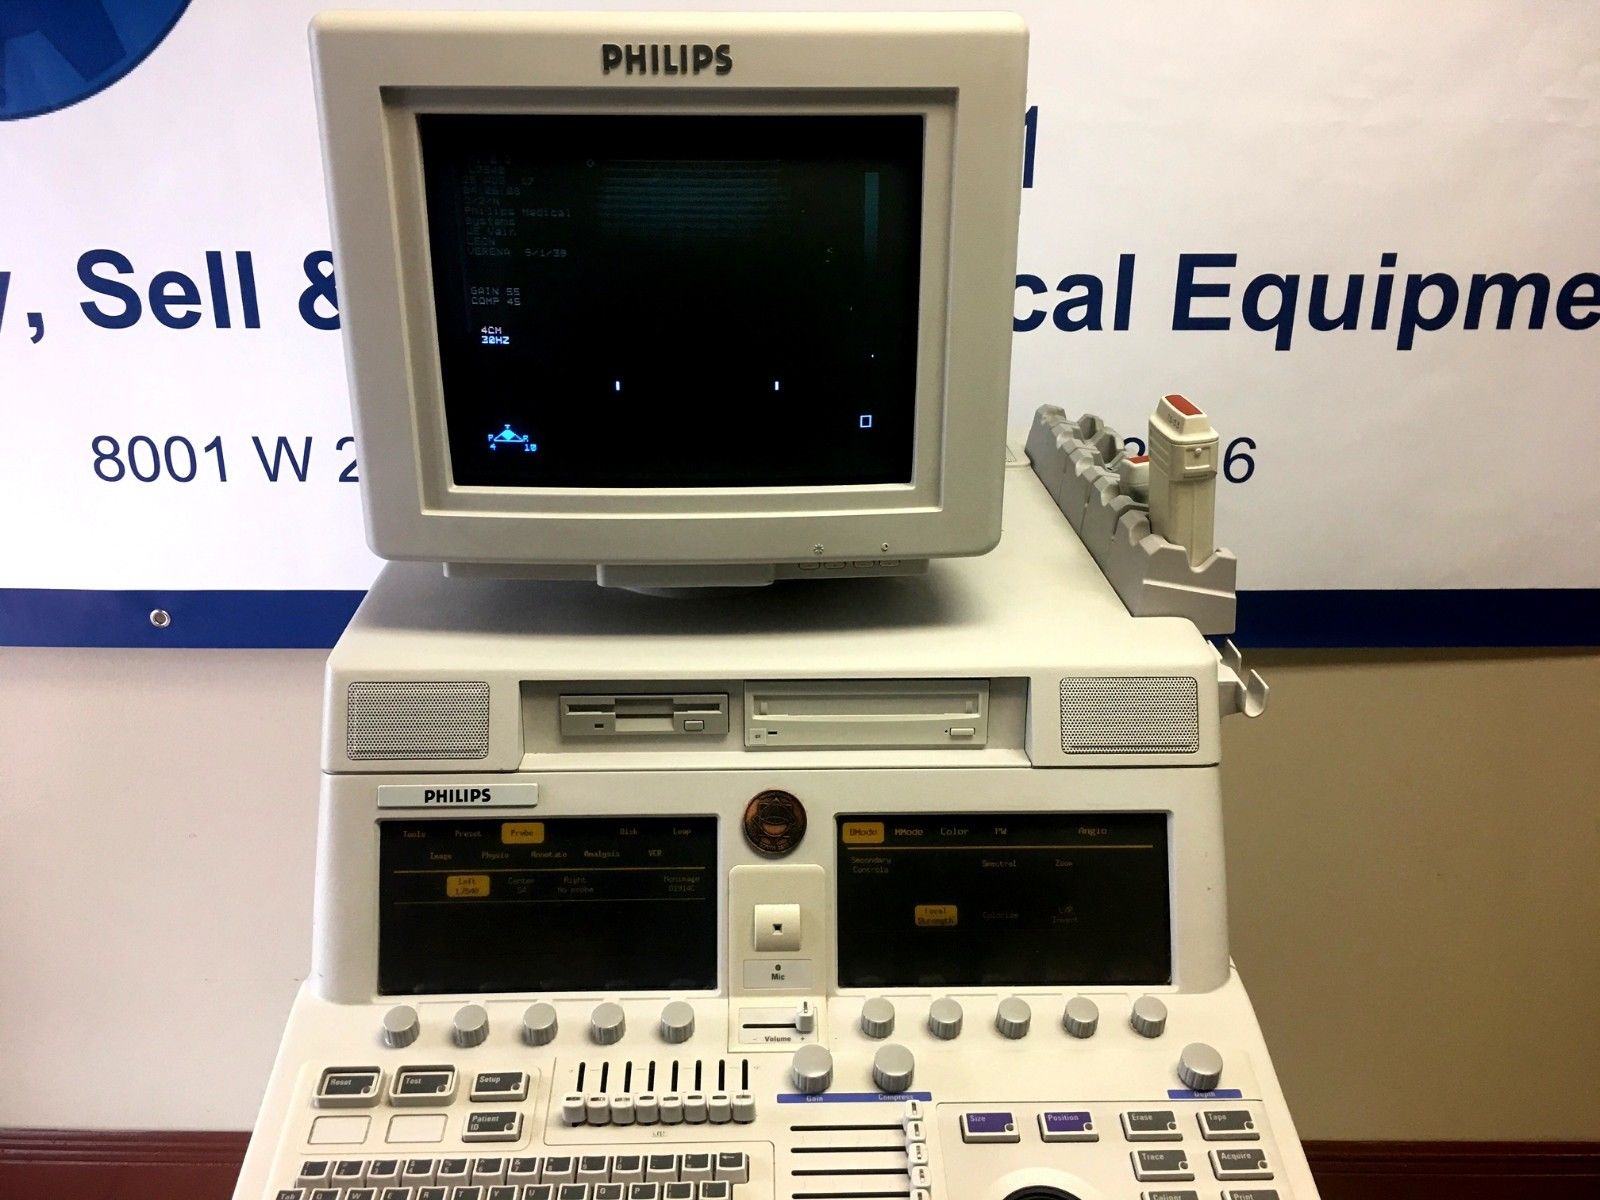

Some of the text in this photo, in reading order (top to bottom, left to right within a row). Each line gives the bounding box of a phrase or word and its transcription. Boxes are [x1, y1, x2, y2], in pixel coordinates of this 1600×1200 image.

[602, 43, 733, 75] PHILIPS
[521, 207, 570, 217] Medical
[77, 248, 260, 330] Sell
[471, 286, 500, 295] GAIN
[472, 297, 500, 305] COMP
[481, 326, 502, 335] 4CM
[481, 336, 510, 345] 30HZ
[92, 435, 227, 483] 8001
[252, 436, 313, 482] W
[424, 788, 491, 804] PHILIPS
[510, 829, 534, 838] Probe
[894, 828, 924, 837] MMode
[940, 827, 969, 836] Color
[994, 827, 1008, 835] PW
[1078, 826, 1107, 837] Angio
[430, 852, 452, 862] Image
[531, 851, 567, 859] Annotate
[584, 850, 620, 860] Analysis
[771, 972, 785, 981] Mic
[330, 1078, 352, 1086] Reset
[405, 1077, 422, 1085] Test
[479, 1075, 501, 1084] Setup
[806, 1095, 824, 1103] Gain
[878, 1092, 914, 1102] Compress
[472, 1115, 499, 1123] Patient
[969, 1114, 986, 1123] Size
[1047, 1114, 1079, 1122] Position
[1131, 1113, 1153, 1122] Erase
[1207, 1112, 1227, 1122] Tape
[470, 1122, 479, 1131] ID
[1141, 1152, 1164, 1161] Trace
[1220, 1151, 1252, 1161] Acquire
[634, 1187, 641, 1195] P
[280, 1192, 296, 1200] Tab
